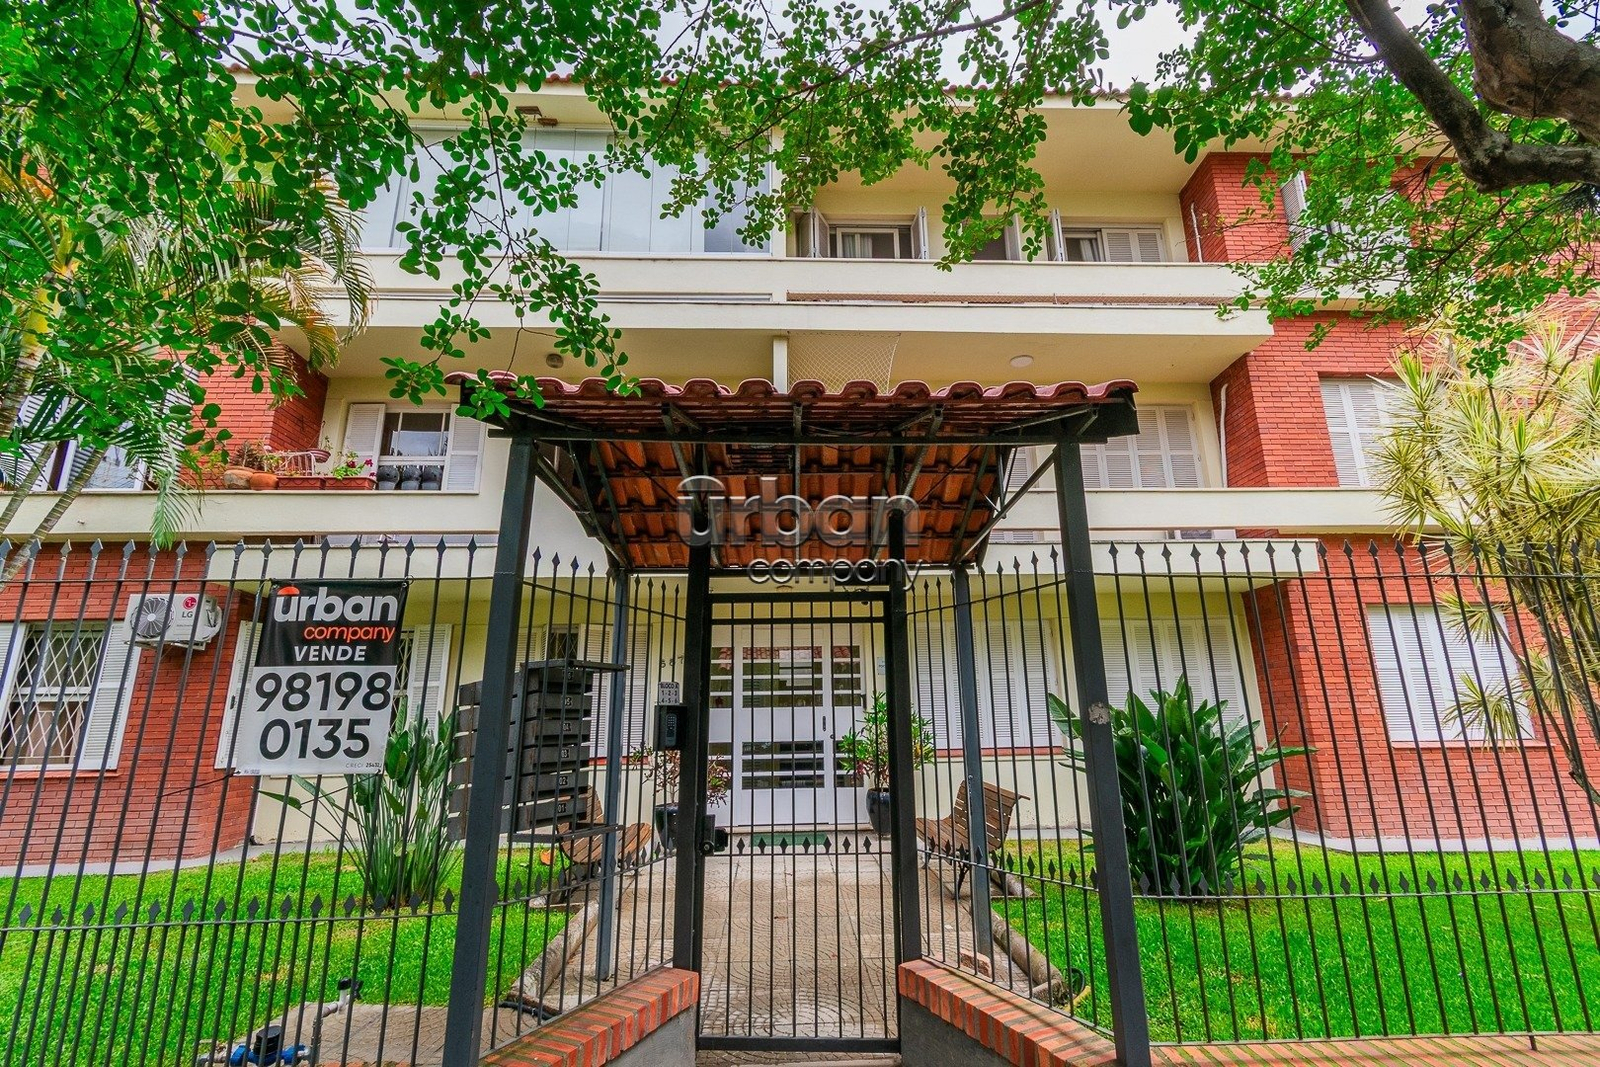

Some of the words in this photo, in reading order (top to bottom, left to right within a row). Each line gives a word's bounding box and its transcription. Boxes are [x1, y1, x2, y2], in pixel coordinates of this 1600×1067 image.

[273, 586, 398, 622] urban
[304, 625, 396, 643] company
[294, 645, 367, 662] VENDE
[255, 671, 392, 712] 98198
[259, 718, 371, 760] 0135
